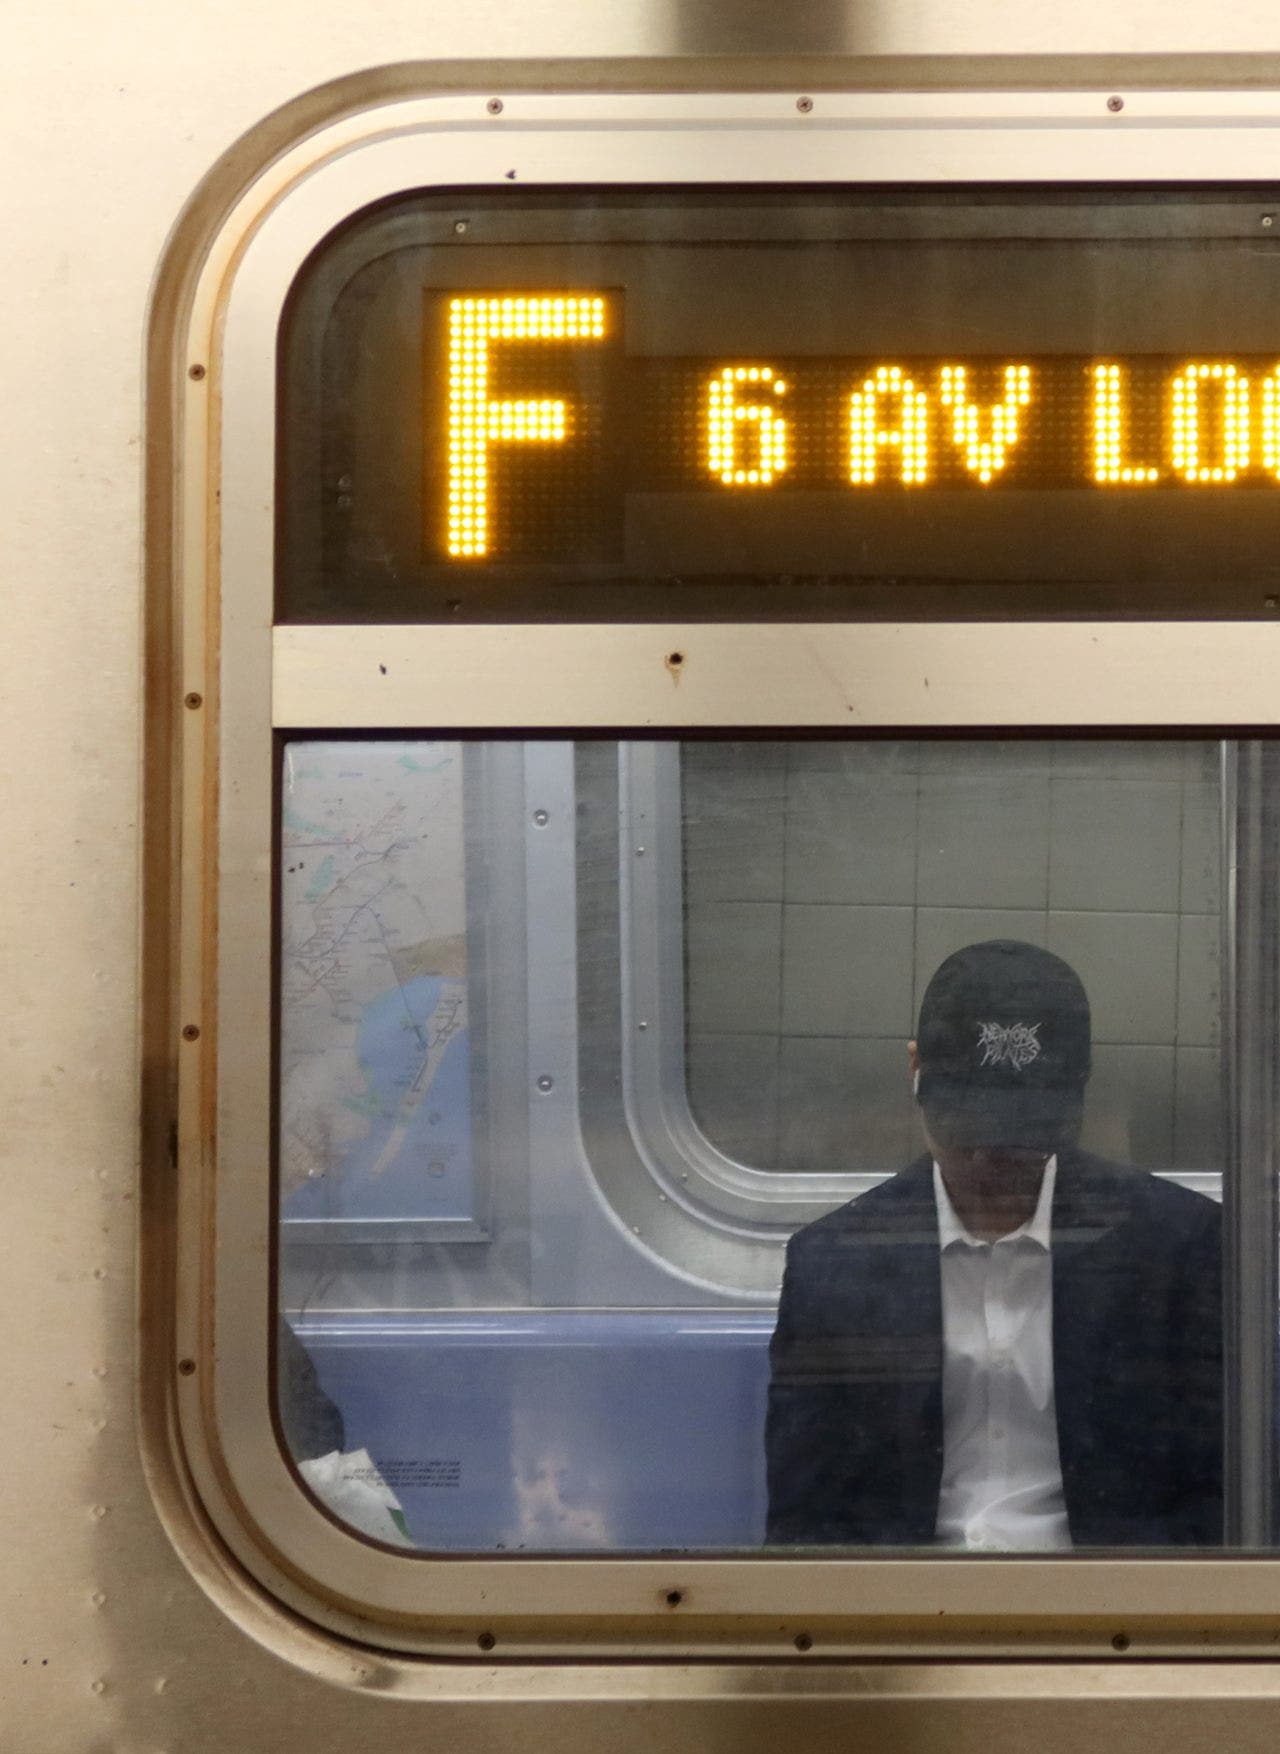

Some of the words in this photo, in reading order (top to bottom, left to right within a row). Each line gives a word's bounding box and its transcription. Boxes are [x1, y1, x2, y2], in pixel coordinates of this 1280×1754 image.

[446, 295, 608, 559] F
[706, 365, 790, 486] 6
[847, 364, 1031, 485] AV
